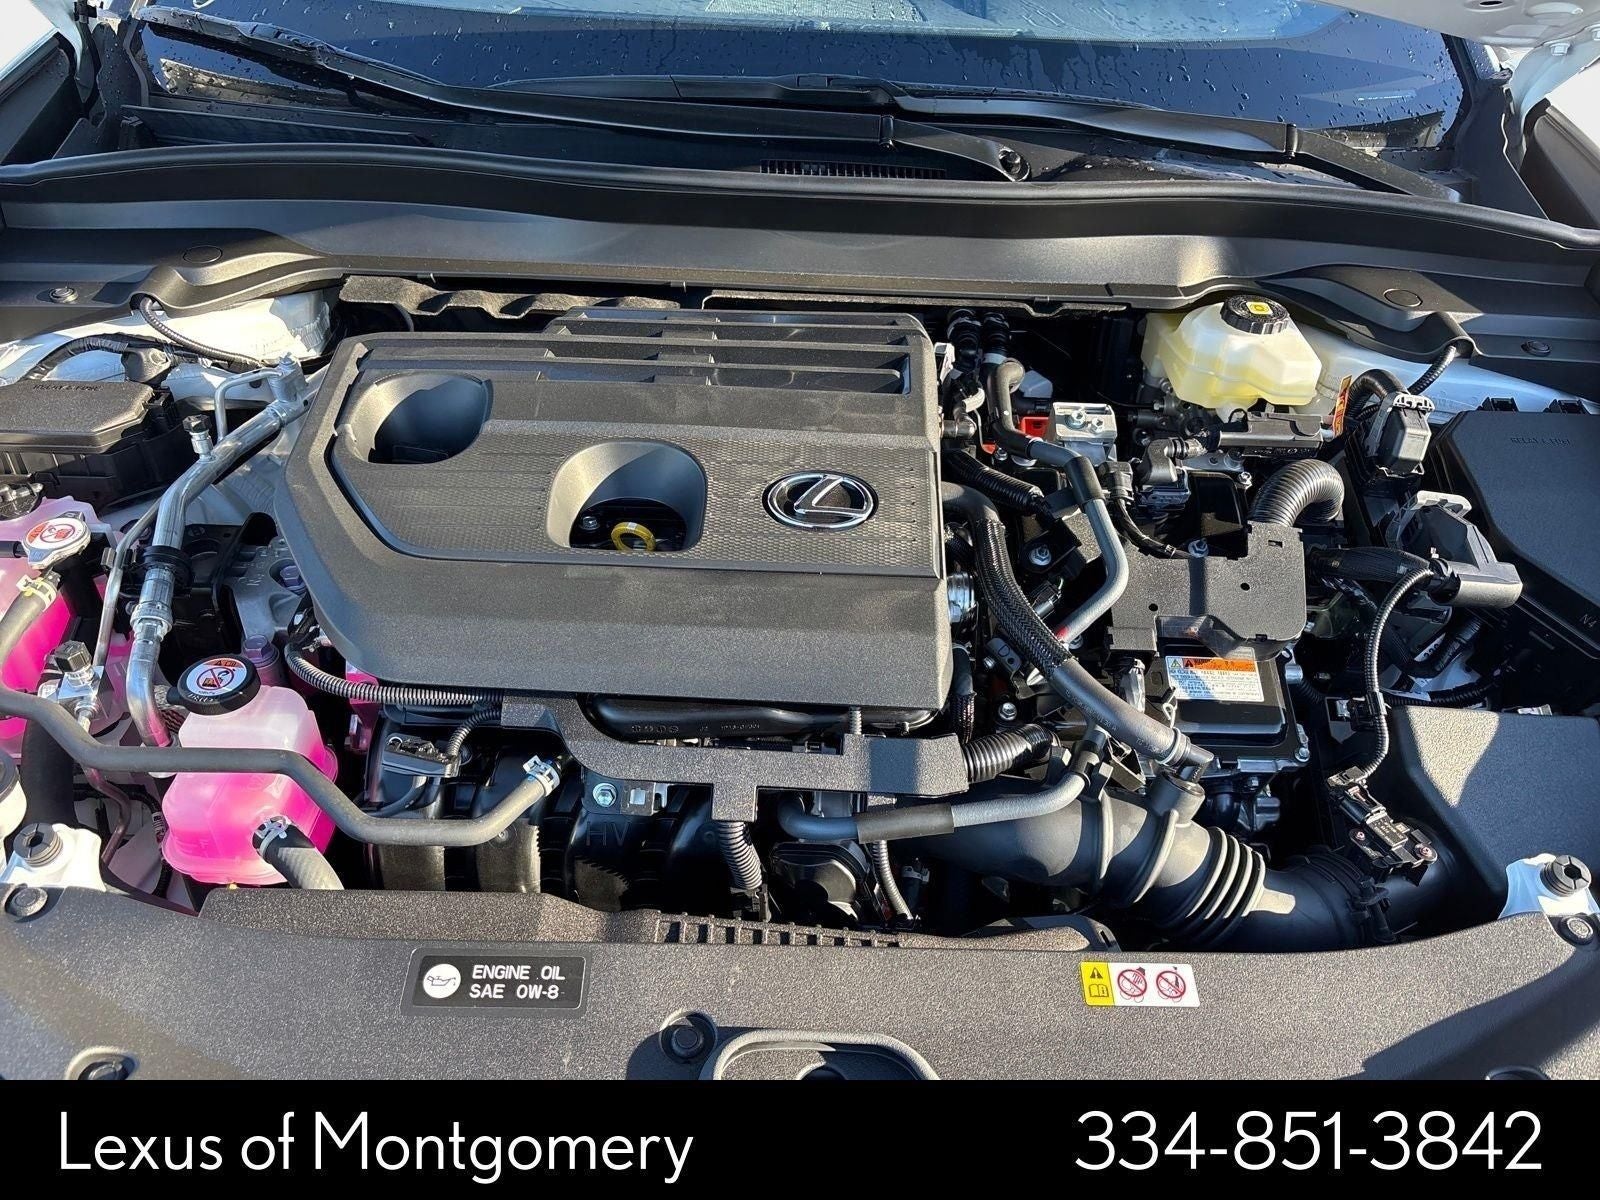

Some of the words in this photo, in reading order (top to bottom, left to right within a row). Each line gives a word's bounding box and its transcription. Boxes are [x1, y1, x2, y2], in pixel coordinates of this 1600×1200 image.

[472, 964, 531, 980] ENGINE
[540, 965, 566, 980] OIL
[469, 983, 505, 999] SAE
[516, 984, 560, 1000] 0W-8
